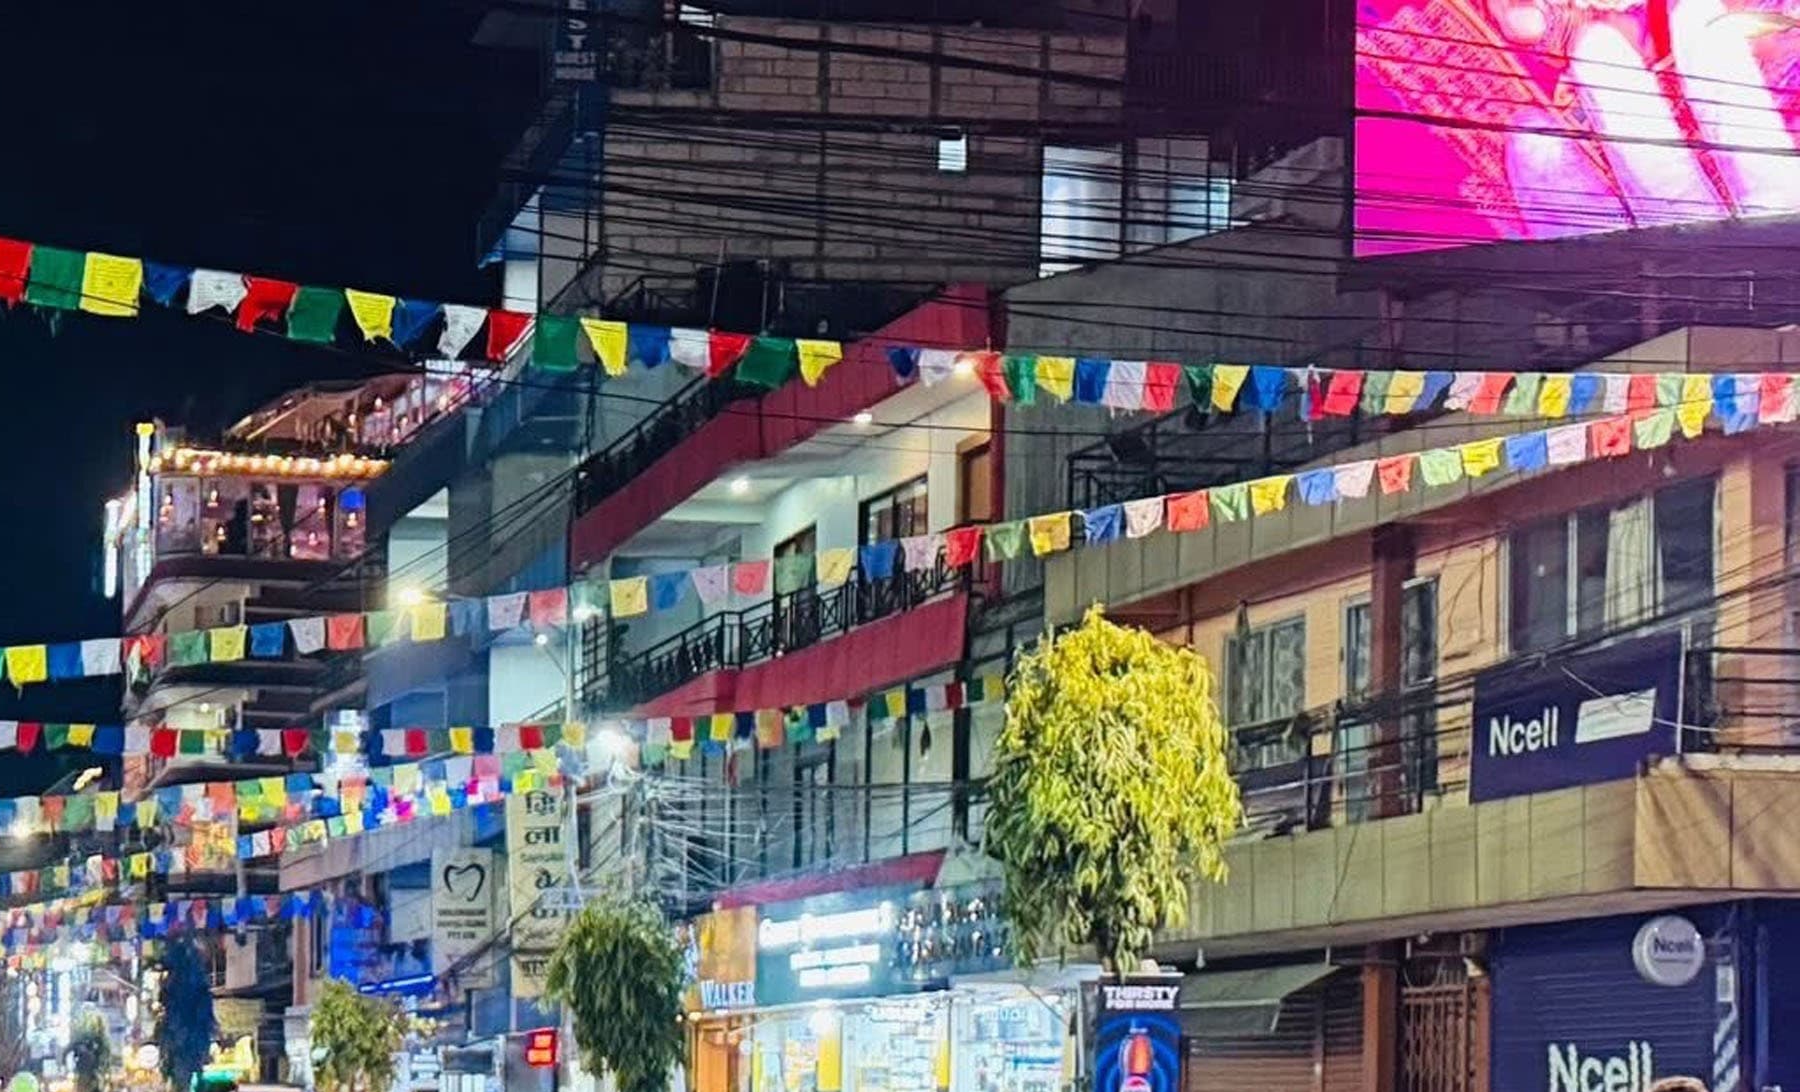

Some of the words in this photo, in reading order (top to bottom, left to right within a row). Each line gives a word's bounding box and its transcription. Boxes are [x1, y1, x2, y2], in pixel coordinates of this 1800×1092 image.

[1489, 706, 1559, 757] Ncell
[701, 980, 756, 1008] WALKER
[1103, 986, 1180, 1000] THIRSTY
